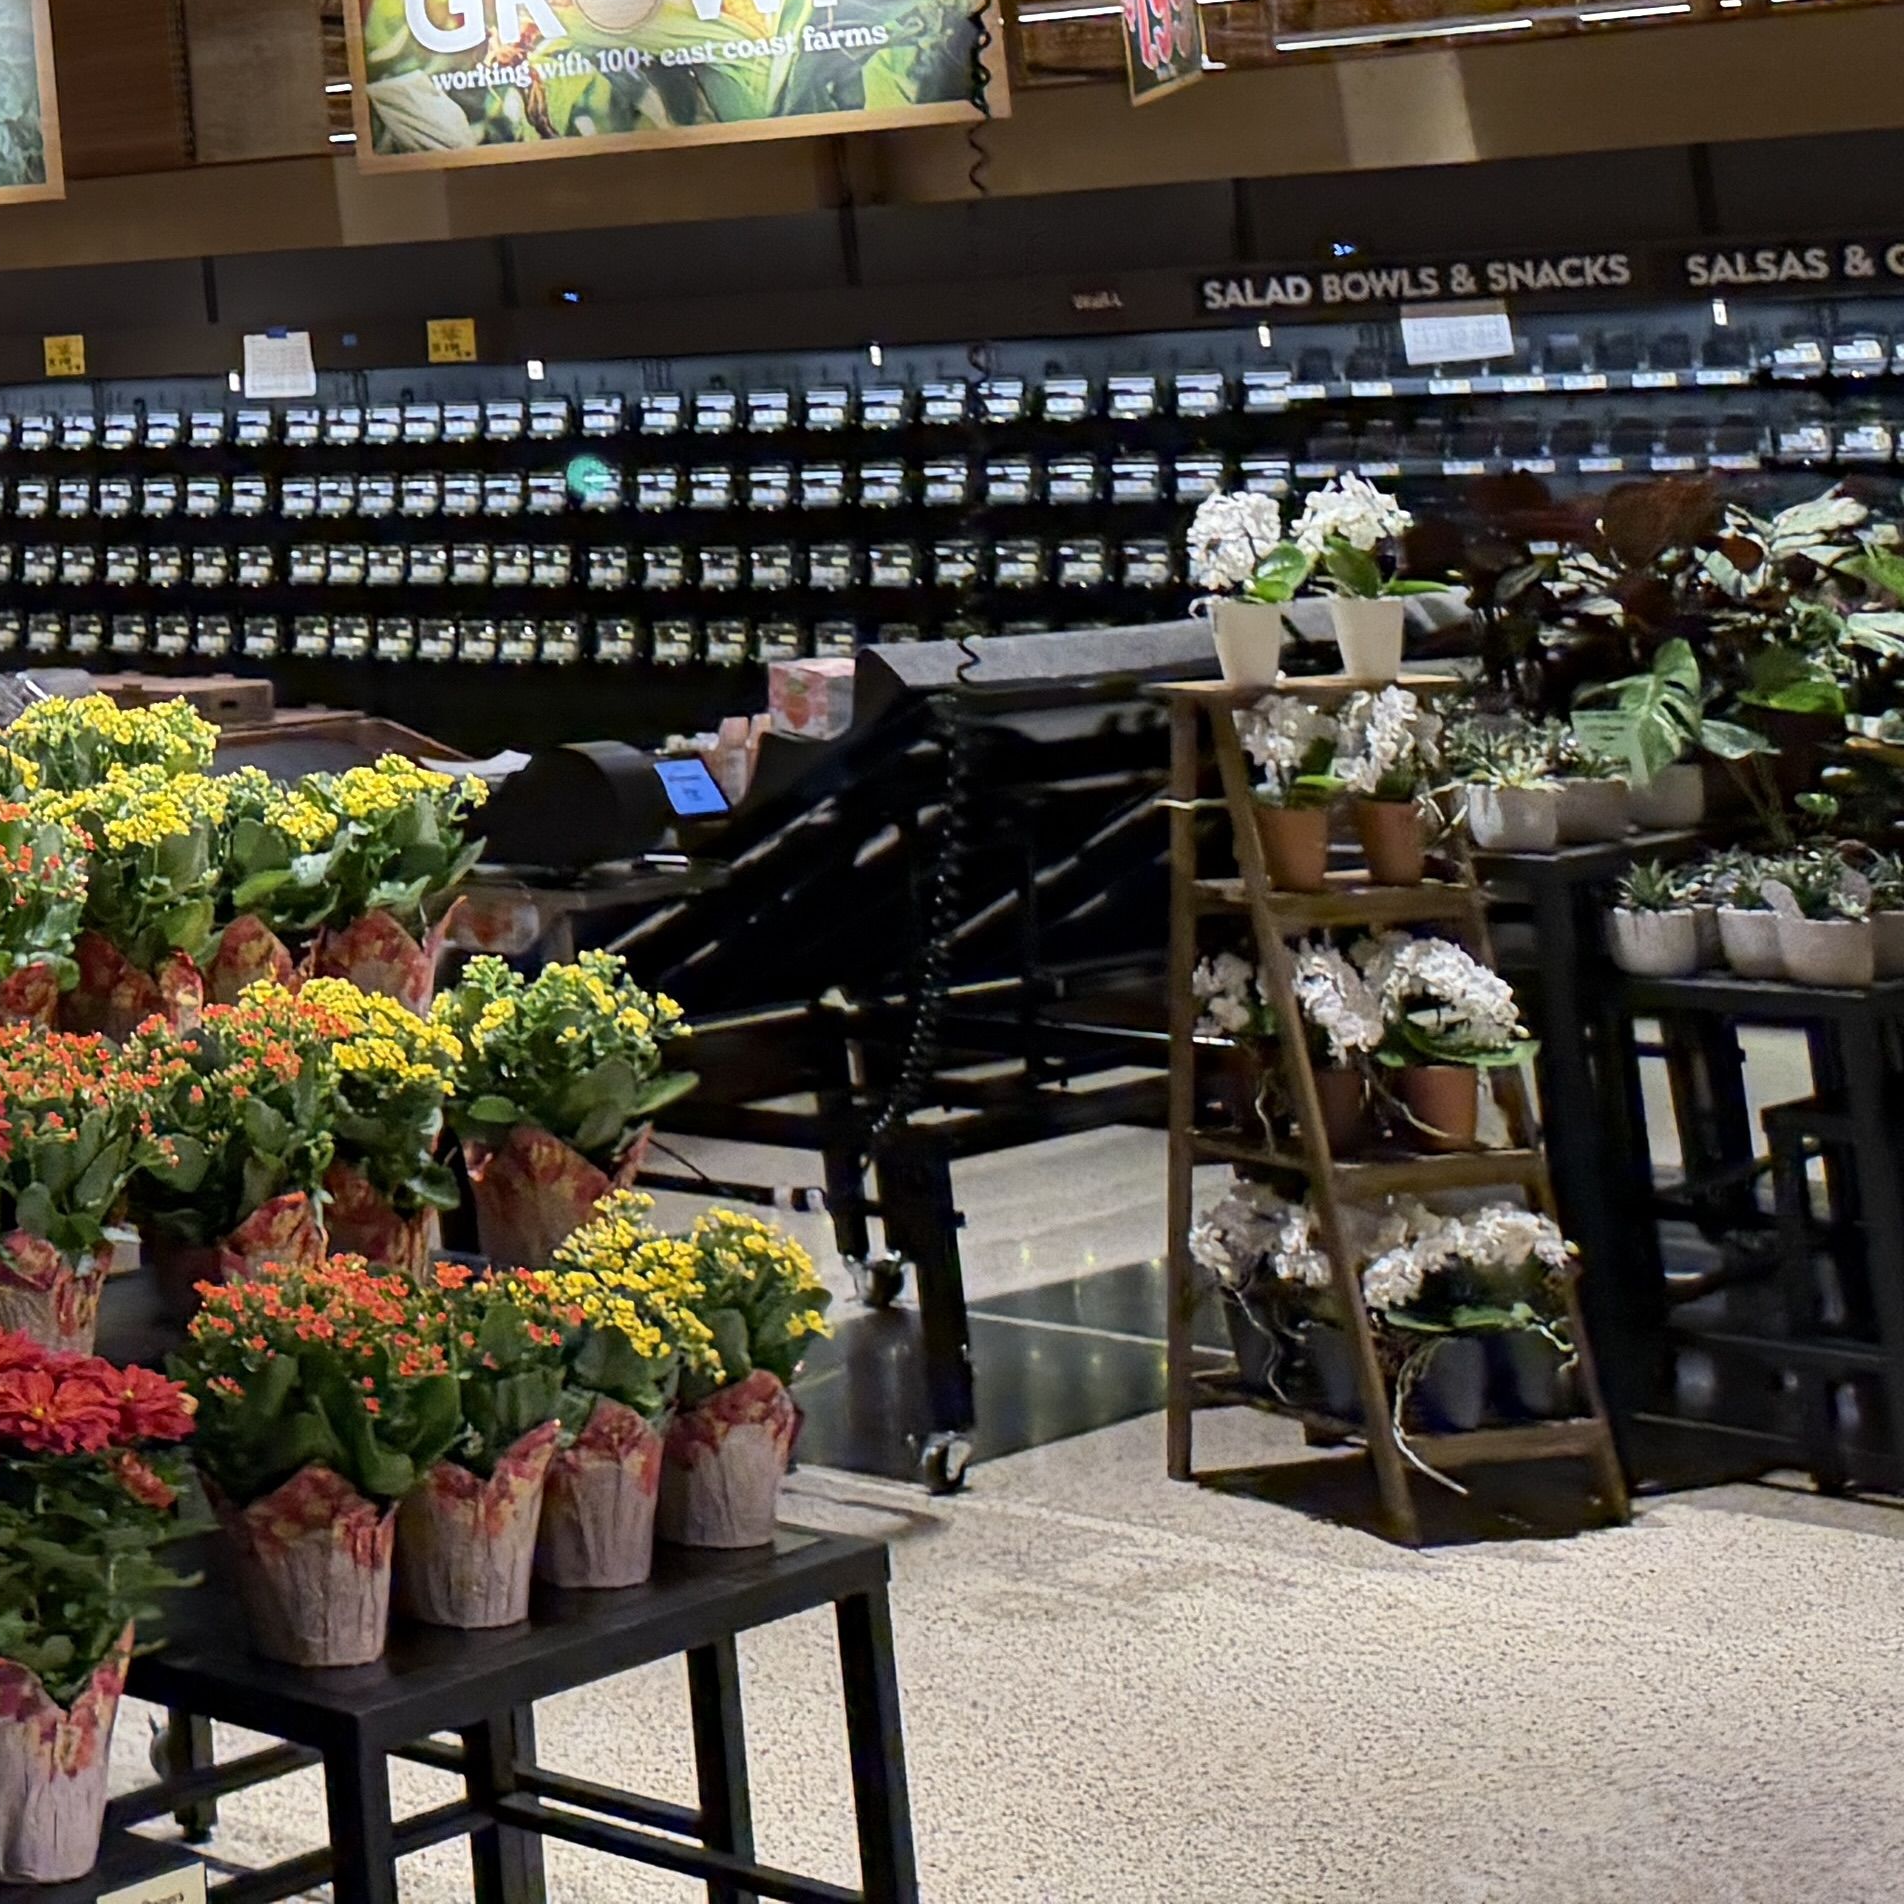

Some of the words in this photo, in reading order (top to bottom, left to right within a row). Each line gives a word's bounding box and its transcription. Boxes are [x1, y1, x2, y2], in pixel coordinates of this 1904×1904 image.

[432, 61, 531, 92] working
[538, 52, 590, 81] with
[596, 48, 654, 75] 100+
[660, 43, 718, 72] east
[723, 33, 794, 64] coast
[802, 24, 890, 52] farms
[1204, 275, 1312, 310] SALAD
[1322, 264, 1440, 304] BOWLS
[1449, 262, 1478, 292] &
[1488, 255, 1631, 292] SNACKS
[1687, 247, 1830, 286] SALSAS
[1844, 245, 1875, 276] &
